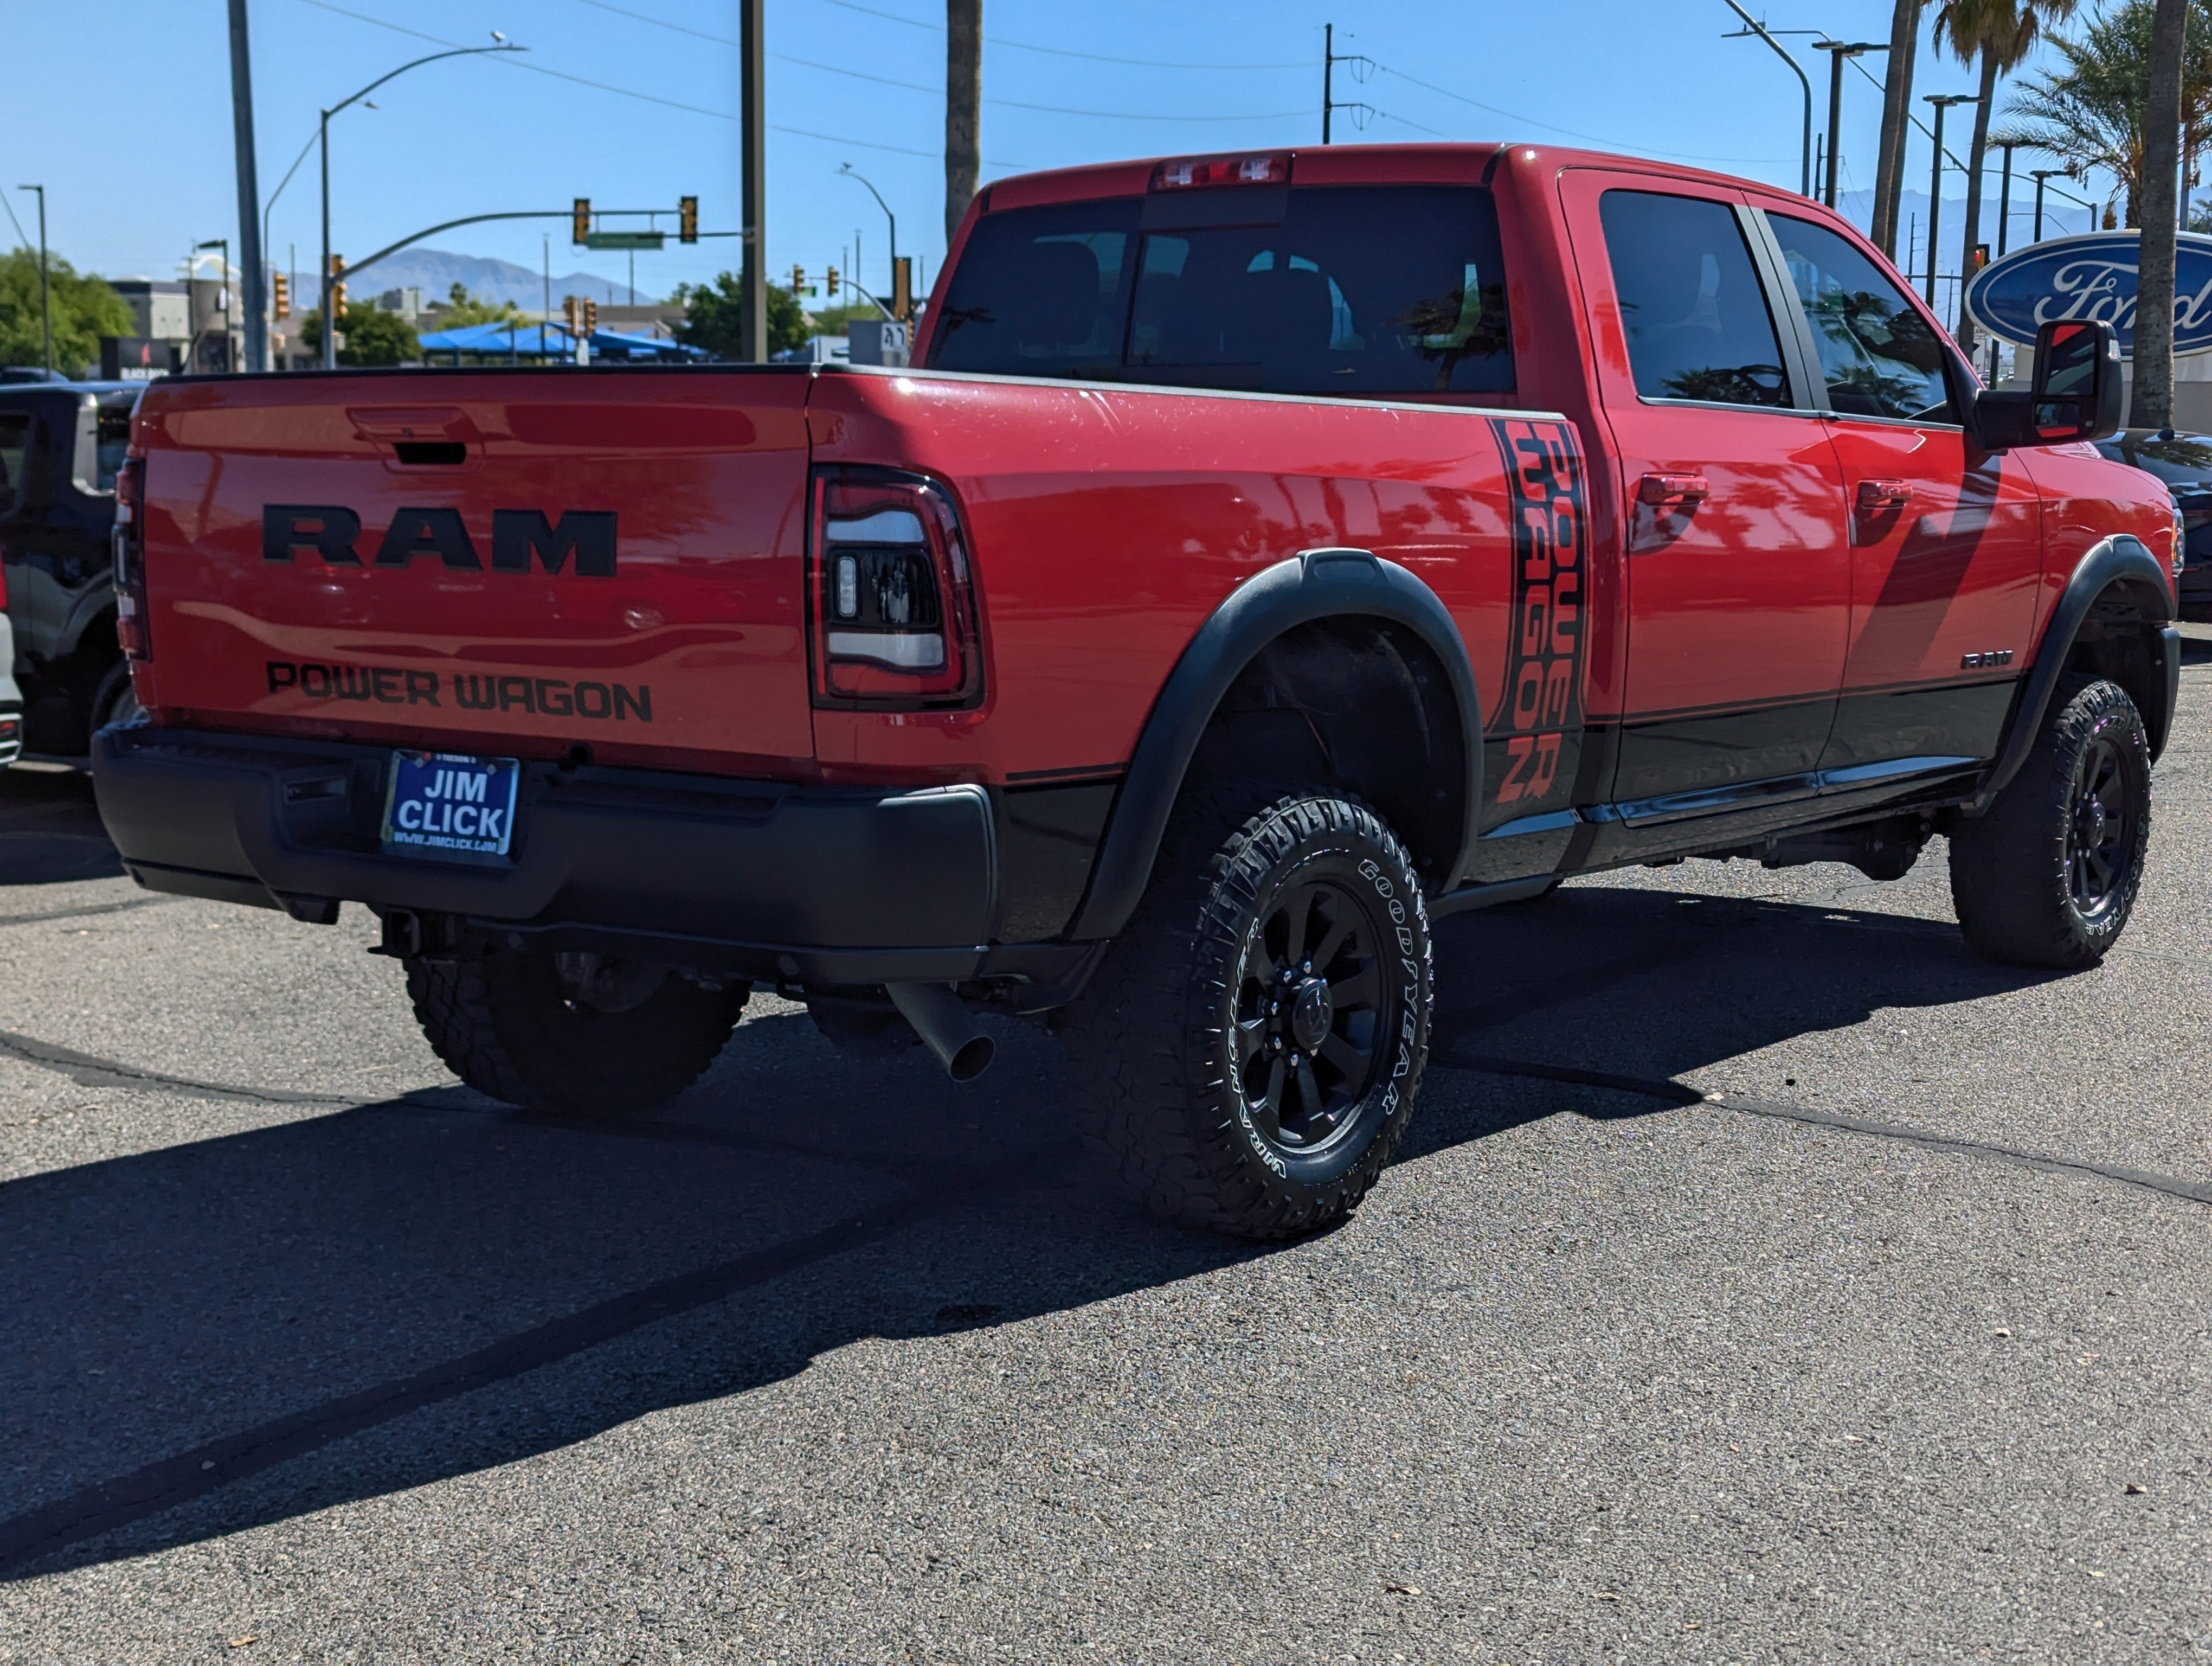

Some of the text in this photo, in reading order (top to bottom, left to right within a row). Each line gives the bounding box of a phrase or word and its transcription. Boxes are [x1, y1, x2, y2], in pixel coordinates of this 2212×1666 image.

[262, 504, 618, 578] RAM
[1497, 420, 1552, 804] WAGON
[1526, 422, 1578, 798] POWER
[266, 661, 653, 723] POWER WAGON
[1962, 650, 2013, 669] RAM
[398, 799, 504, 838] CLICK
[423, 769, 488, 803] JIM
[393, 831, 497, 853] WWW.JIMCLICK.COM
[1358, 858, 1418, 1116] GOODYEAR
[1227, 917, 1287, 1179] WRANGLER
